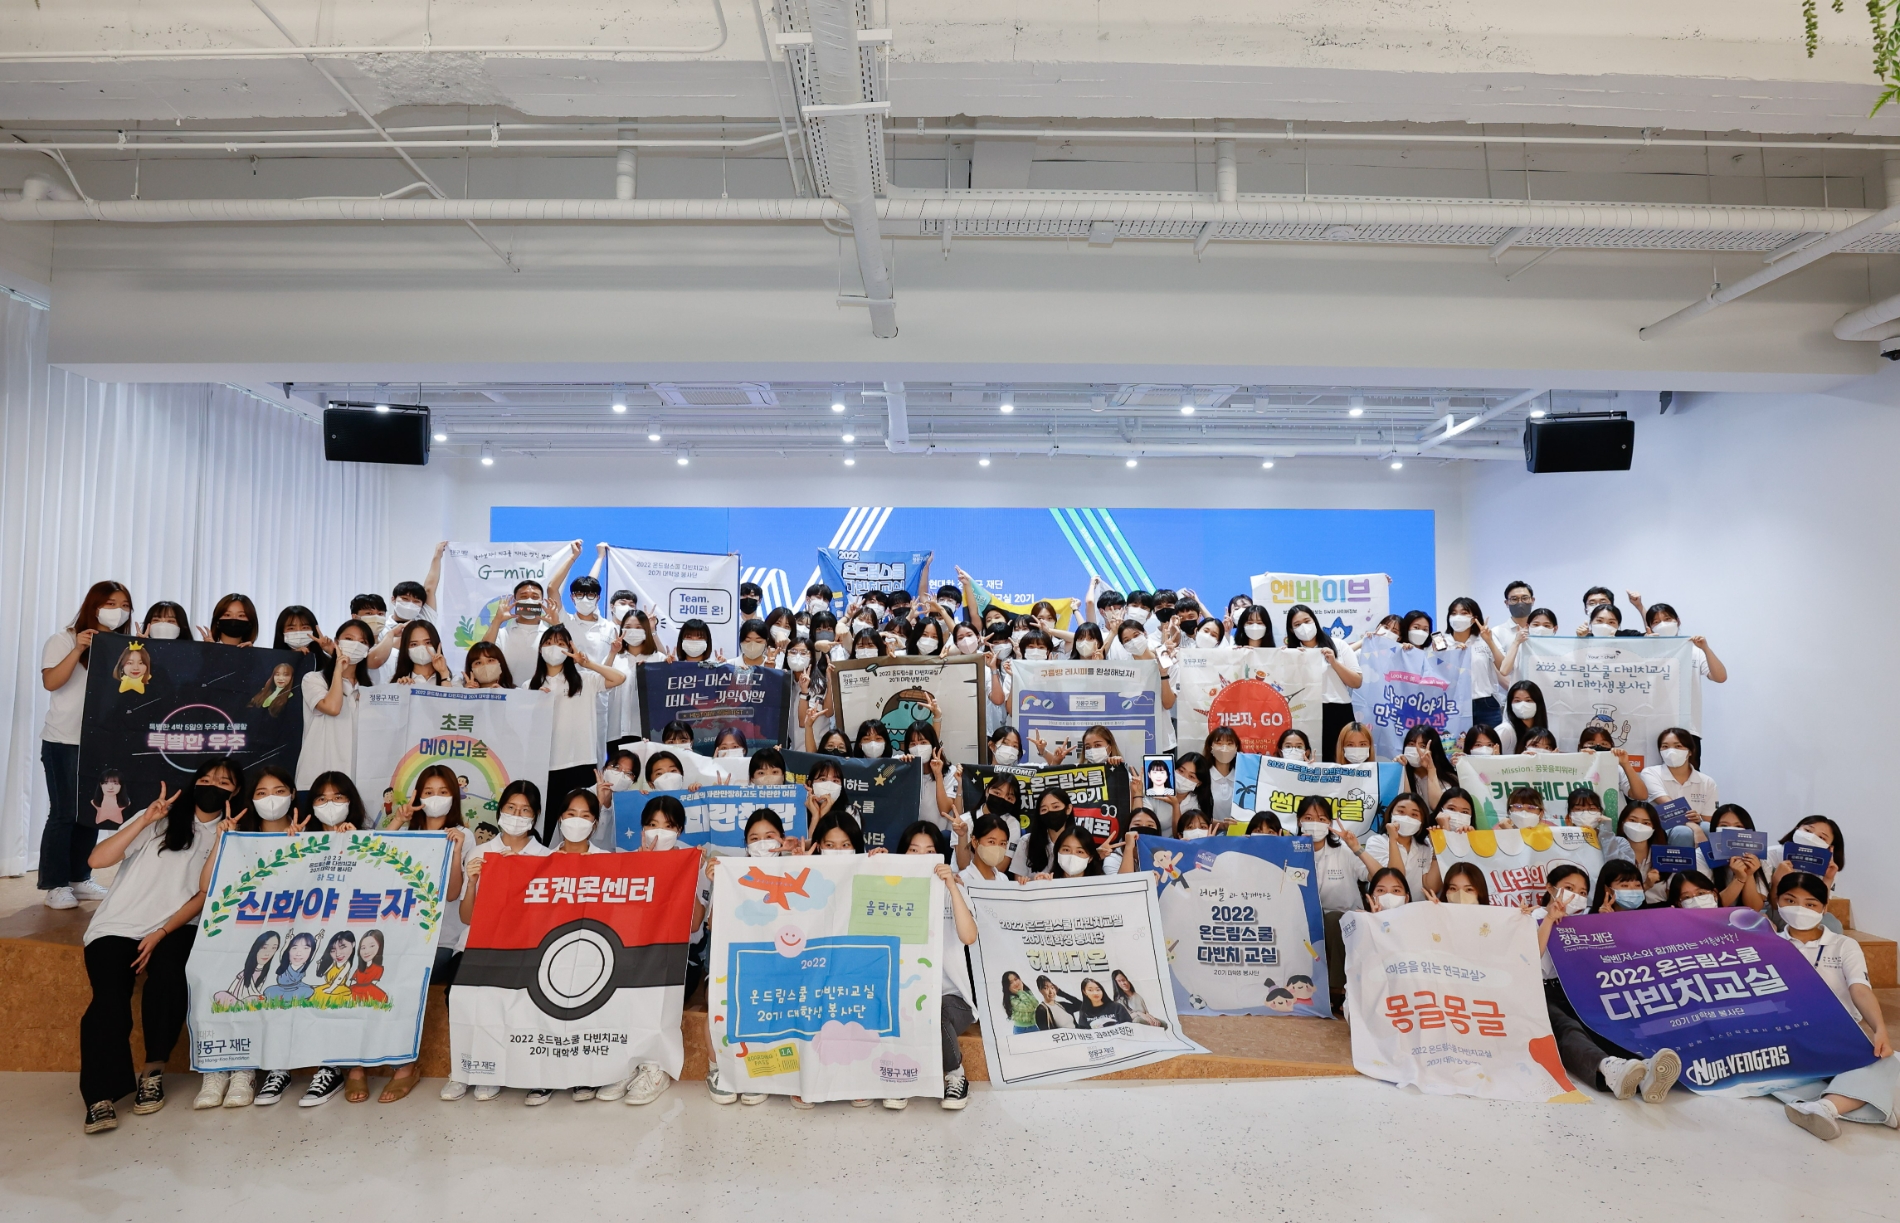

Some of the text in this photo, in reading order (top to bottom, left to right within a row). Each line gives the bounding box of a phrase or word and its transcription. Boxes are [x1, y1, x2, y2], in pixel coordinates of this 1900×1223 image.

[838, 550, 860, 561] 2022
[653, 562, 680, 570] 온드림스쿨
[682, 564, 710, 572] 다빈치교실
[843, 562, 906, 580] 온드림스쿨
[986, 579, 1003, 590] 재단
[1271, 579, 1371, 604] 엔바이브
[680, 594, 709, 603] Team.
[1014, 594, 1034, 603] 20기
[680, 605, 723, 615] 라이트 온!
[736, 672, 763, 686] 타고
[1096, 668, 1135, 679] 완성해보자!
[1558, 664, 1612, 679] 온드림스쿨
[1614, 664, 1670, 680] 다빈치교실
[1554, 680, 1652, 694] 20기 대학생 봉사단
[665, 689, 766, 707] 떠나는 과학여행
[1384, 684, 1459, 715] 나의 이야기로
[440, 714, 474, 732] 초록
[1217, 712, 1283, 728] 가보자, GO
[1374, 703, 1404, 736] 만드는
[148, 732, 246, 750] 특별한 우주
[420, 738, 488, 758] 메아리숲
[994, 765, 1036, 777] WELCOME!
[1267, 760, 1285, 769] 2022
[1501, 764, 1578, 775] Mission: 꿈꽃을피워라!
[1030, 770, 1103, 792] 온드림스쿨
[759, 790, 781, 798] 찬란한
[782, 790, 796, 798] 여름
[1068, 786, 1102, 804] 20기
[1561, 832, 1580, 841] 정몽구
[1490, 865, 1548, 893] 나만의
[524, 876, 655, 904] 포켓몬센터
[236, 888, 417, 924] 신화야 놀자
[867, 900, 914, 918] 올랑항공
[1211, 906, 1254, 921] 2022
[999, 914, 1124, 932] 2022 온드림스쿨 다빈치교실
[1022, 932, 1104, 946] 20기 대학생 봉사단
[1199, 925, 1273, 942] 온드림스쿨
[1559, 932, 1614, 945] 정몽구 재단
[1654, 932, 1740, 955] 함께하는 여름방학!
[1026, 949, 1110, 973] 하나다온
[1197, 946, 1277, 963] 다빈치 교실
[801, 958, 826, 969] 2022
[1421, 962, 1441, 974] 읽는
[1595, 946, 1762, 989] 2022 온드림스쿨
[750, 984, 874, 1004] 온드림스쿨 다빈치교실
[1599, 964, 1789, 1021] 다빈치교실
[757, 1003, 866, 1022] 20기 대학생 봉사단
[1385, 991, 1507, 1037] 몽글몽글
[1670, 1016, 1690, 1027] 20기
[1692, 1010, 1717, 1023] 대학생
[198, 1030, 214, 1040] 대차
[510, 1033, 628, 1046] 2022 온드림스쿨 다빈치교실
[1052, 1032, 1077, 1043] 우리가
[230, 1038, 251, 1051] 재단
[530, 1045, 609, 1058] 20기 대학생 봉사단
[1412, 1047, 1427, 1055] 2022
[747, 1054, 773, 1062] BOARDING
[781, 1048, 792, 1056] 1A
[482, 1061, 496, 1069] 재단
[879, 1067, 918, 1077] 정몽구 재단
